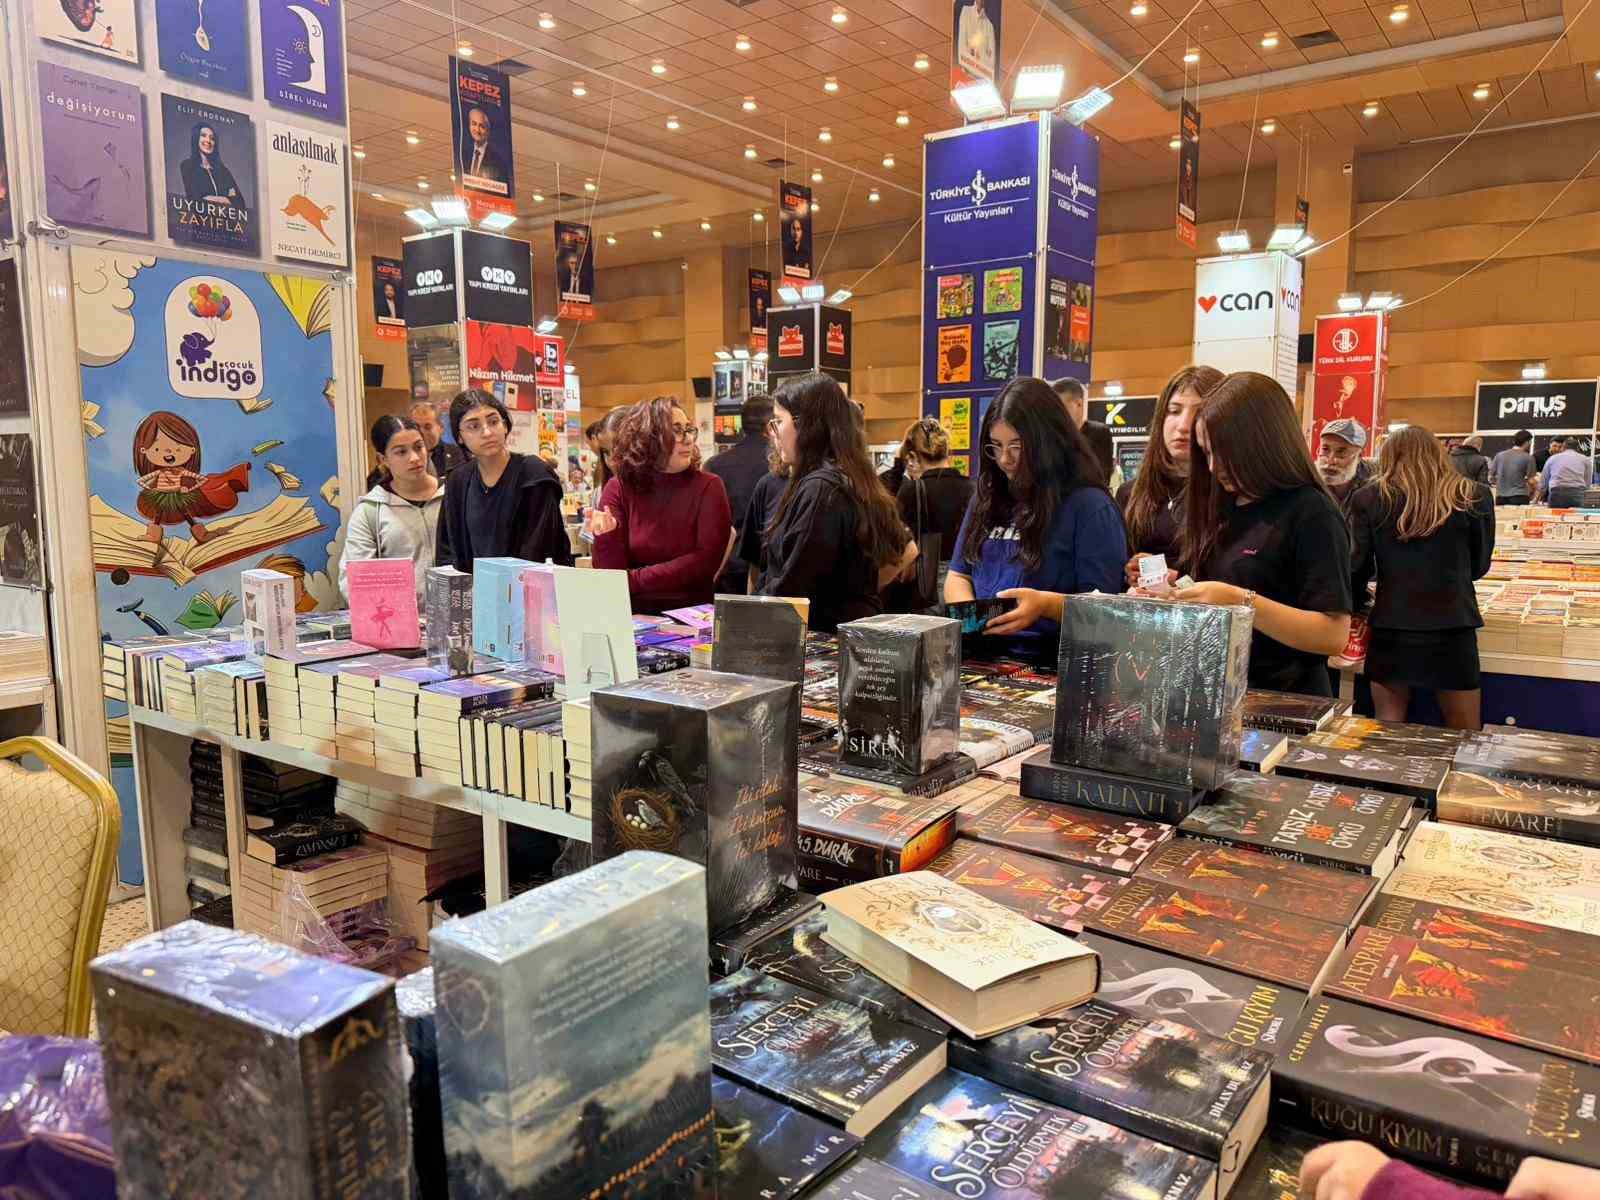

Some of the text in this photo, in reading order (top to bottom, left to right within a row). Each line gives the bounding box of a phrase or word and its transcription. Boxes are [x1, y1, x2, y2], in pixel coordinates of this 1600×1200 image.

[459, 75, 501, 98] KEPEZ
[272, 132, 338, 165] anlaşılmak
[929, 175, 1031, 201] TÜRKİYE BANKASI
[1051, 167, 1097, 198] TÜRKİYE BANKASI
[172, 197, 249, 222] UYURKEN
[943, 206, 1014, 224] Kültür Yayınları
[480, 266, 516, 285] YKY
[1219, 290, 1273, 312] can
[176, 358, 257, 391] indigo
[500, 368, 535, 384] Hikmet
[1499, 394, 1566, 418] pinus
[849, 735, 906, 760] SİREN
[1303, 783, 1337, 809] TATSIZ
[1272, 808, 1315, 844] TATSIZ
[1326, 822, 1366, 849] ÖYKÜ
[814, 838, 856, 868] DURAK
[1310, 1097, 1374, 1132] KUĞU
[1379, 1116, 1444, 1158] KIYIM
[801, 1135, 845, 1165] NUR
